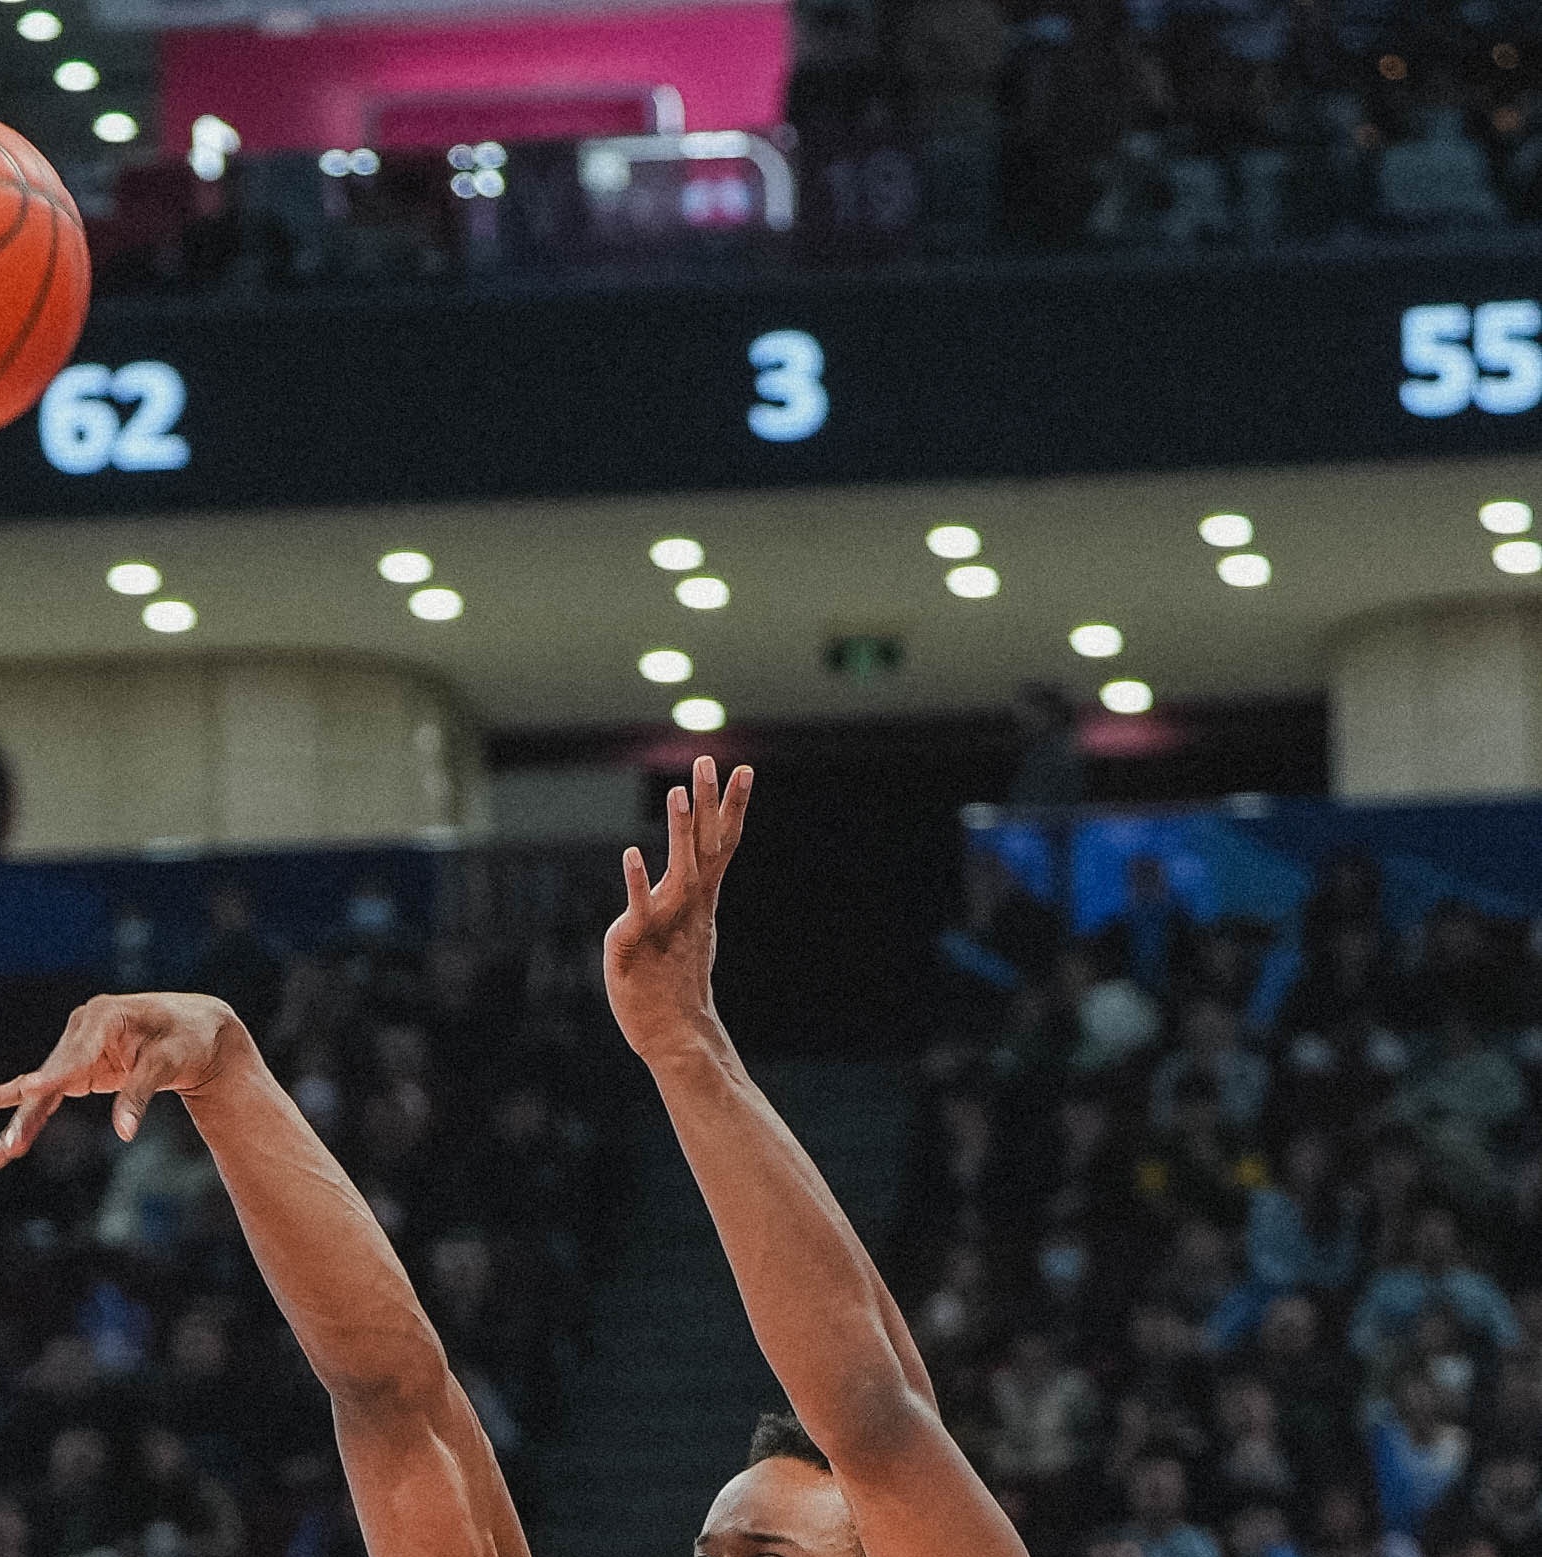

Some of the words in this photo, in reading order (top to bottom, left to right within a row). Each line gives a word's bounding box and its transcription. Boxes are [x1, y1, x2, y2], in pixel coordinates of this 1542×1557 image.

[747, 329, 829, 442] 3
[1398, 299, 1542, 420] 55
[38, 360, 191, 474] 62
